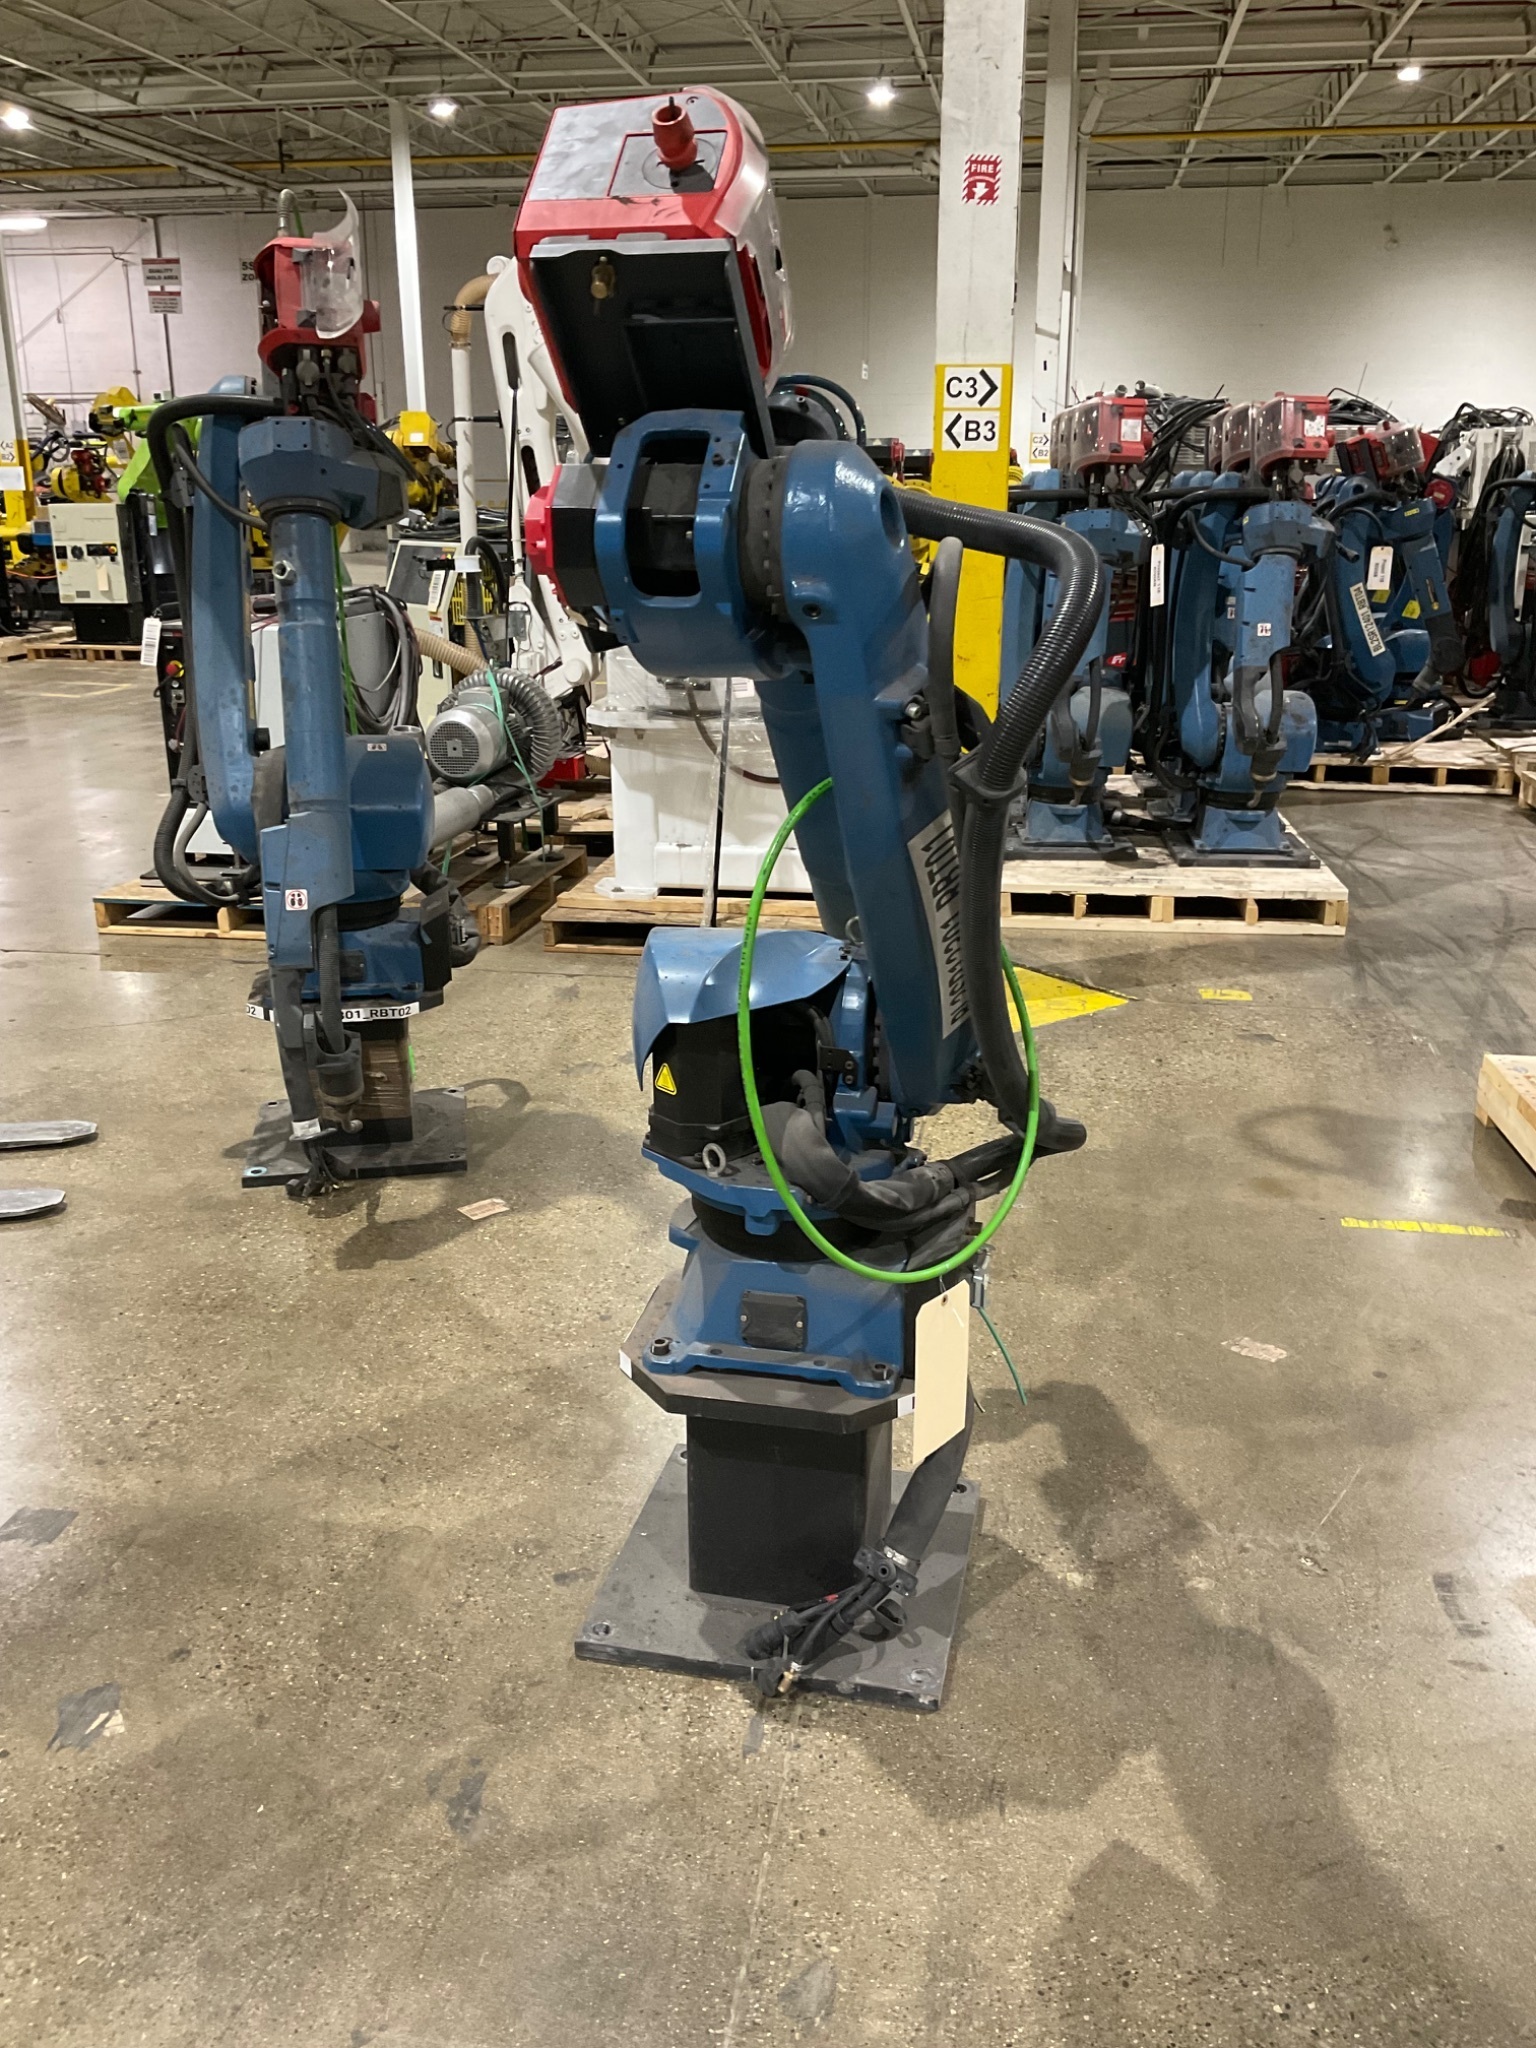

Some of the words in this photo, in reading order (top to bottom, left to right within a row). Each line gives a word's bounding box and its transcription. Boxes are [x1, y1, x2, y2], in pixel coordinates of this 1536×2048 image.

[971, 163, 994, 173] FIRE
[945, 376, 978, 399] C3
[963, 421, 996, 443] B3
[1032, 436, 1044, 444] C2
[1038, 449, 1049, 457] B2
[340, 1006, 411, 1020] 01_RBT02
